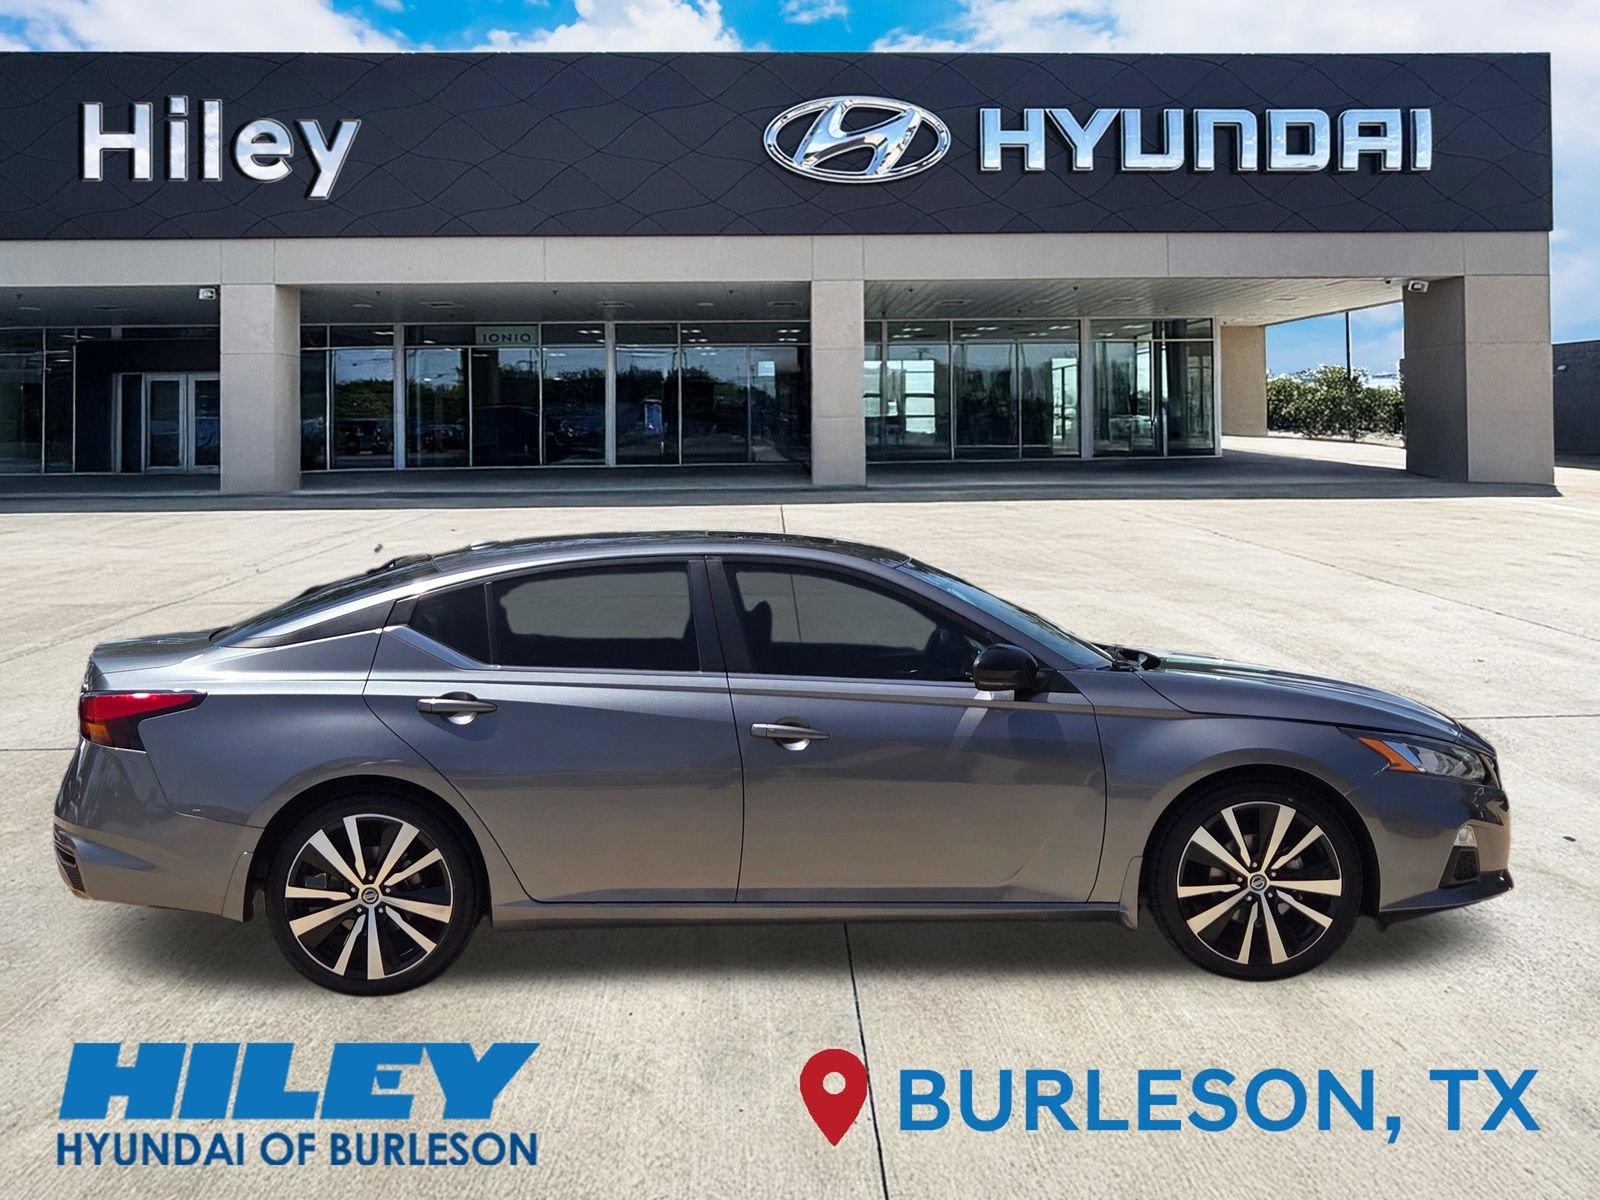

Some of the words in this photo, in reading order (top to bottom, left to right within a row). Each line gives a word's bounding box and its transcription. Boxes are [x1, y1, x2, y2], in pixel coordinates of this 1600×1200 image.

[80, 95, 362, 199] Hiley
[979, 107, 1434, 173] HYUNDAI
[482, 332, 532, 343] IONIQ
